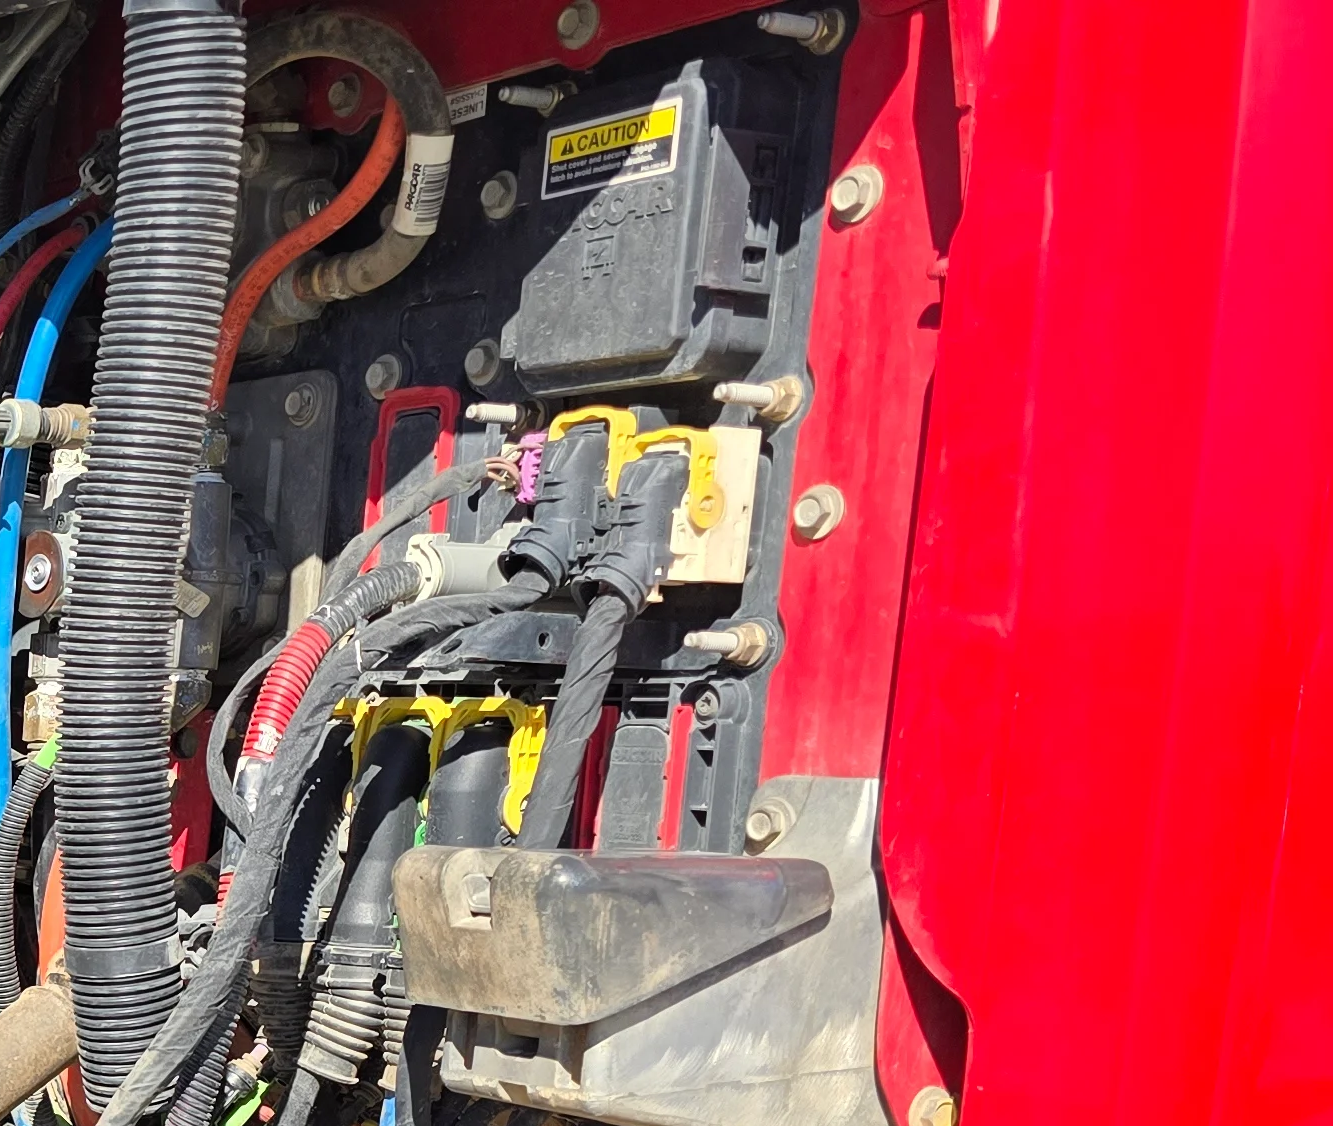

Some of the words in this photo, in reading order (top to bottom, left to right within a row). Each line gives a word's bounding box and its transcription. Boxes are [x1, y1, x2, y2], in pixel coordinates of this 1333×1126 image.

[577, 118, 650, 152] CAUTION
[588, 154, 601, 164] and
[404, 163, 422, 211] PACCAR
